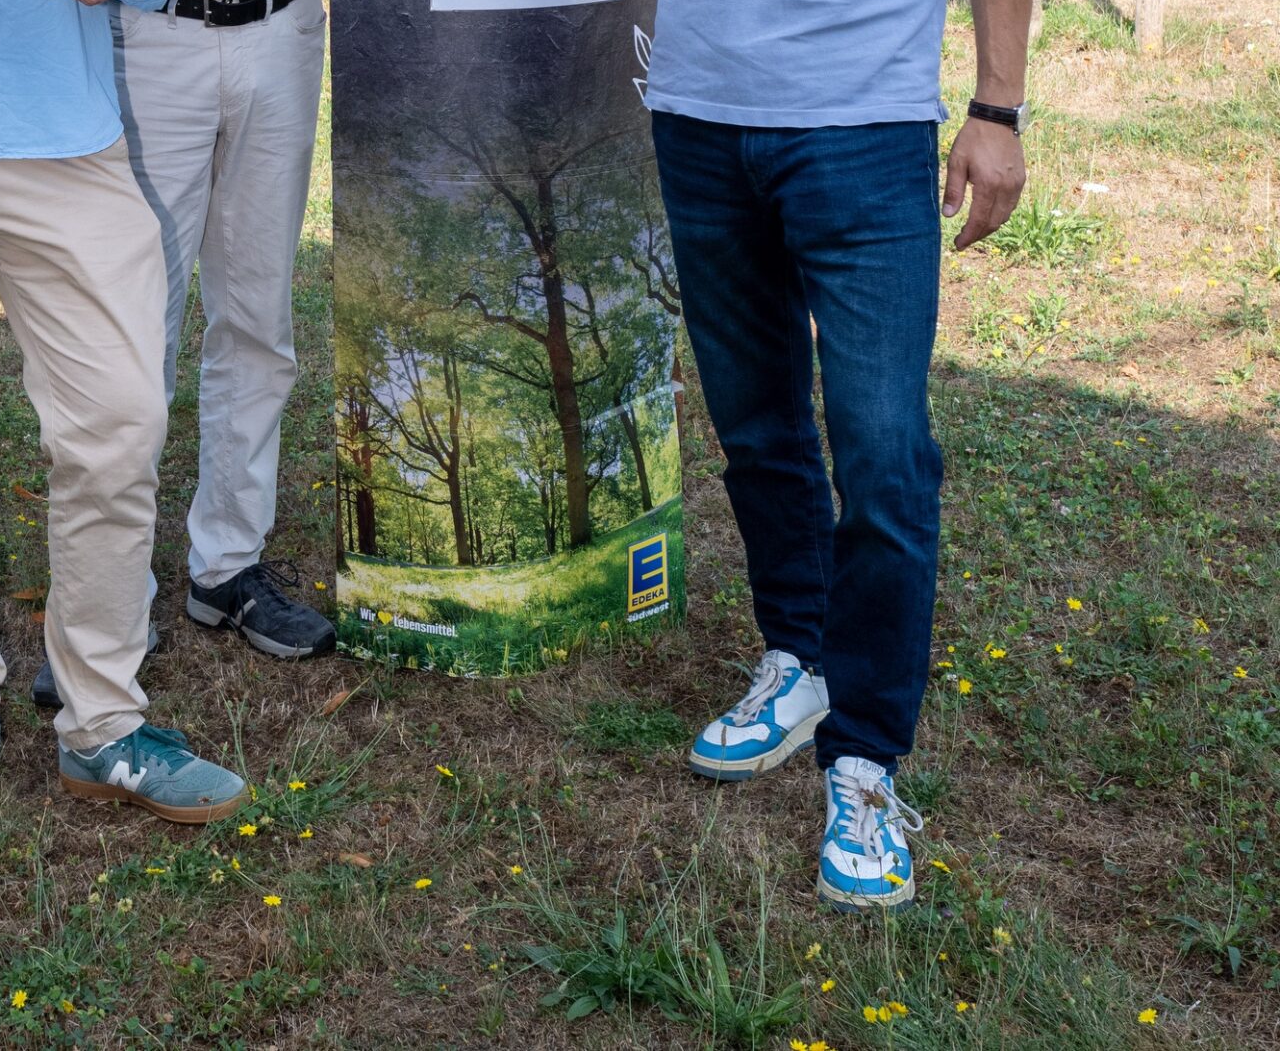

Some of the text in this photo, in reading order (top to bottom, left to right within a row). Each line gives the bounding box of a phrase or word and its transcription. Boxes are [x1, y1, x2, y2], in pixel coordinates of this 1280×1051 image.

[632, 588, 664, 606] EDEKA
[360, 607, 458, 637] Wir Lebensmittel.
